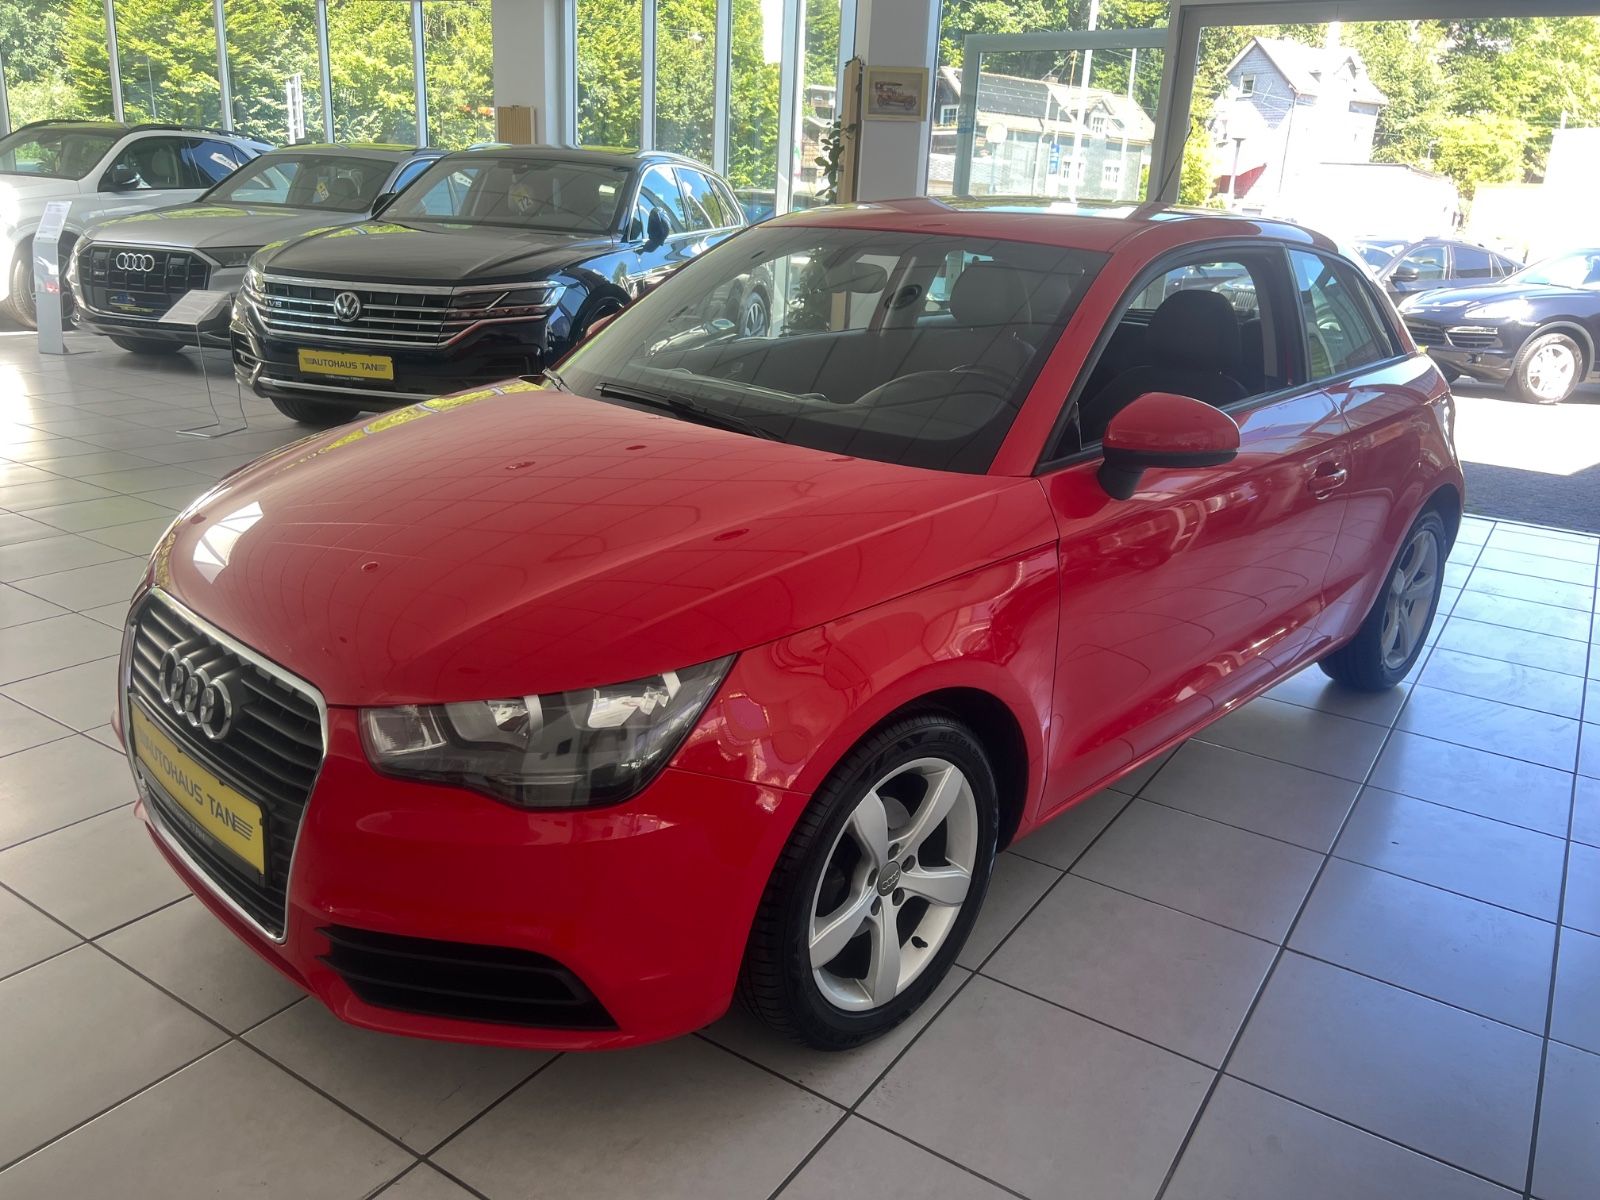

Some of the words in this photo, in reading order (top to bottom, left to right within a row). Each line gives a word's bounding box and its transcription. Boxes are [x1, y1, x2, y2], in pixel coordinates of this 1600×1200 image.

[312, 358, 357, 369] AUTOHAUS
[360, 362, 377, 371] TAN
[147, 737, 204, 806] AUTOHAUS
[206, 794, 238, 833] TAN
